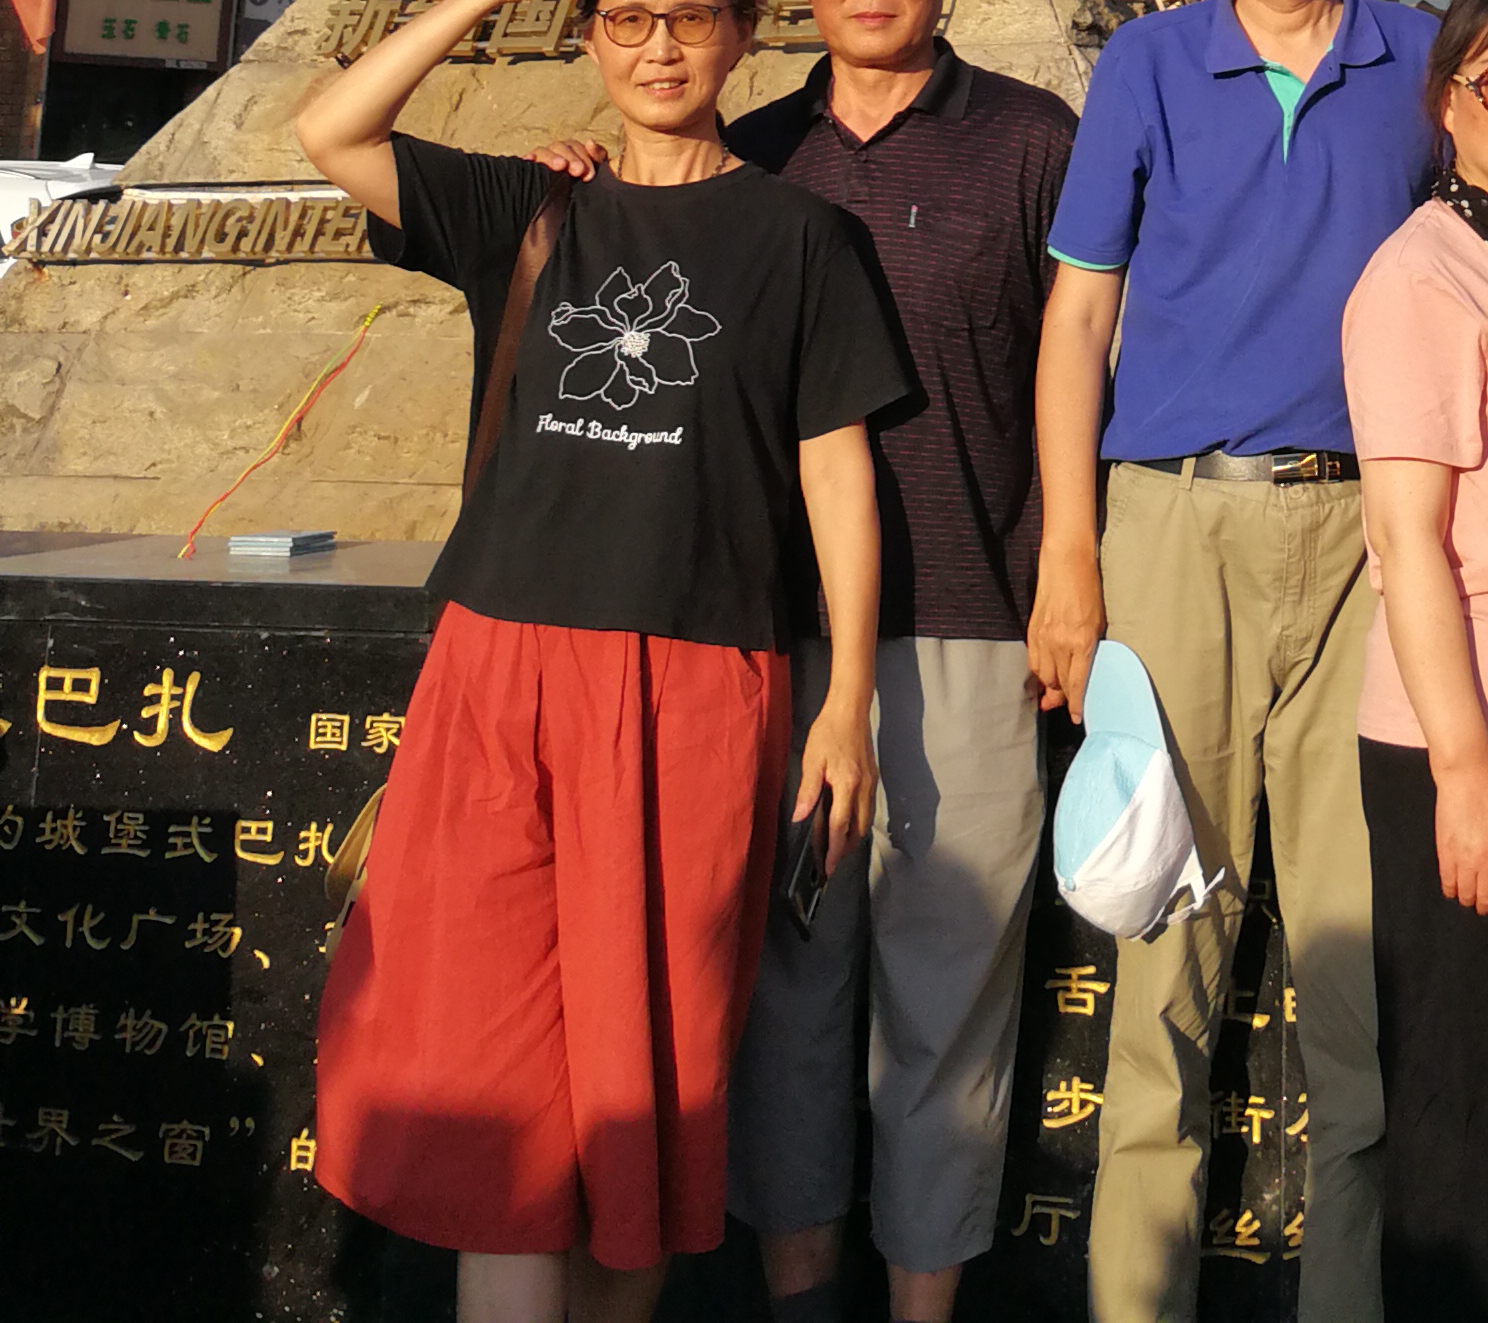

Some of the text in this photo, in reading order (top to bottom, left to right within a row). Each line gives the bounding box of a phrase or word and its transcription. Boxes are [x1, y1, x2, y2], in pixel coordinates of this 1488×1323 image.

[536, 413, 684, 452] Floral Background
[0, 666, 234, 753] 巴扎
[0, 898, 335, 971] 文化广场、
